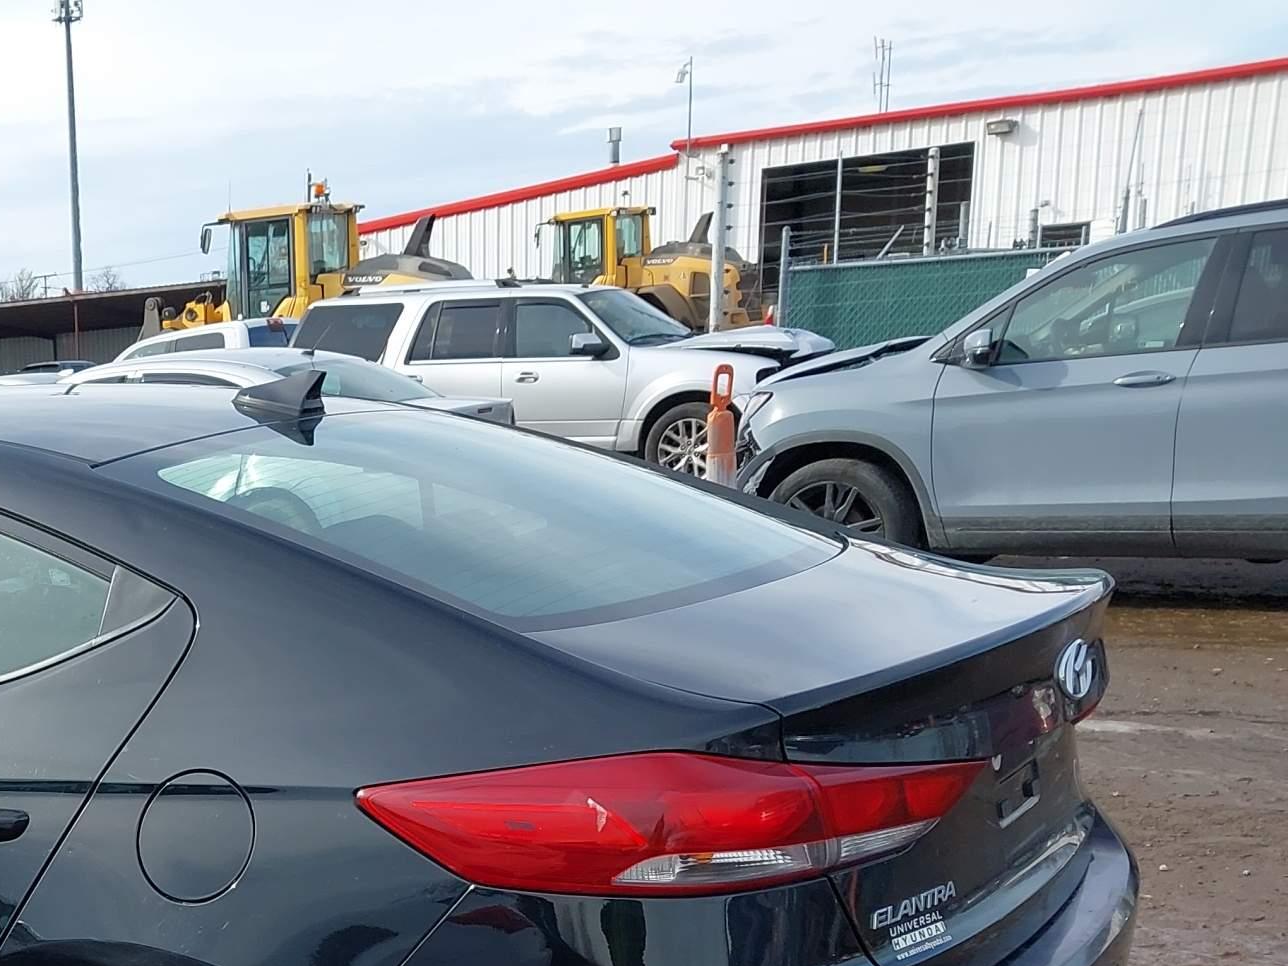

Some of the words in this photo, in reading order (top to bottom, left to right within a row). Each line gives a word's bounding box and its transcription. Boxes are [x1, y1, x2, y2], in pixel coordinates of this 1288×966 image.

[872, 881, 956, 930] ELANTRA
[889, 911, 943, 937] UNIVERSAL
[893, 923, 946, 949] HYUNDAI
